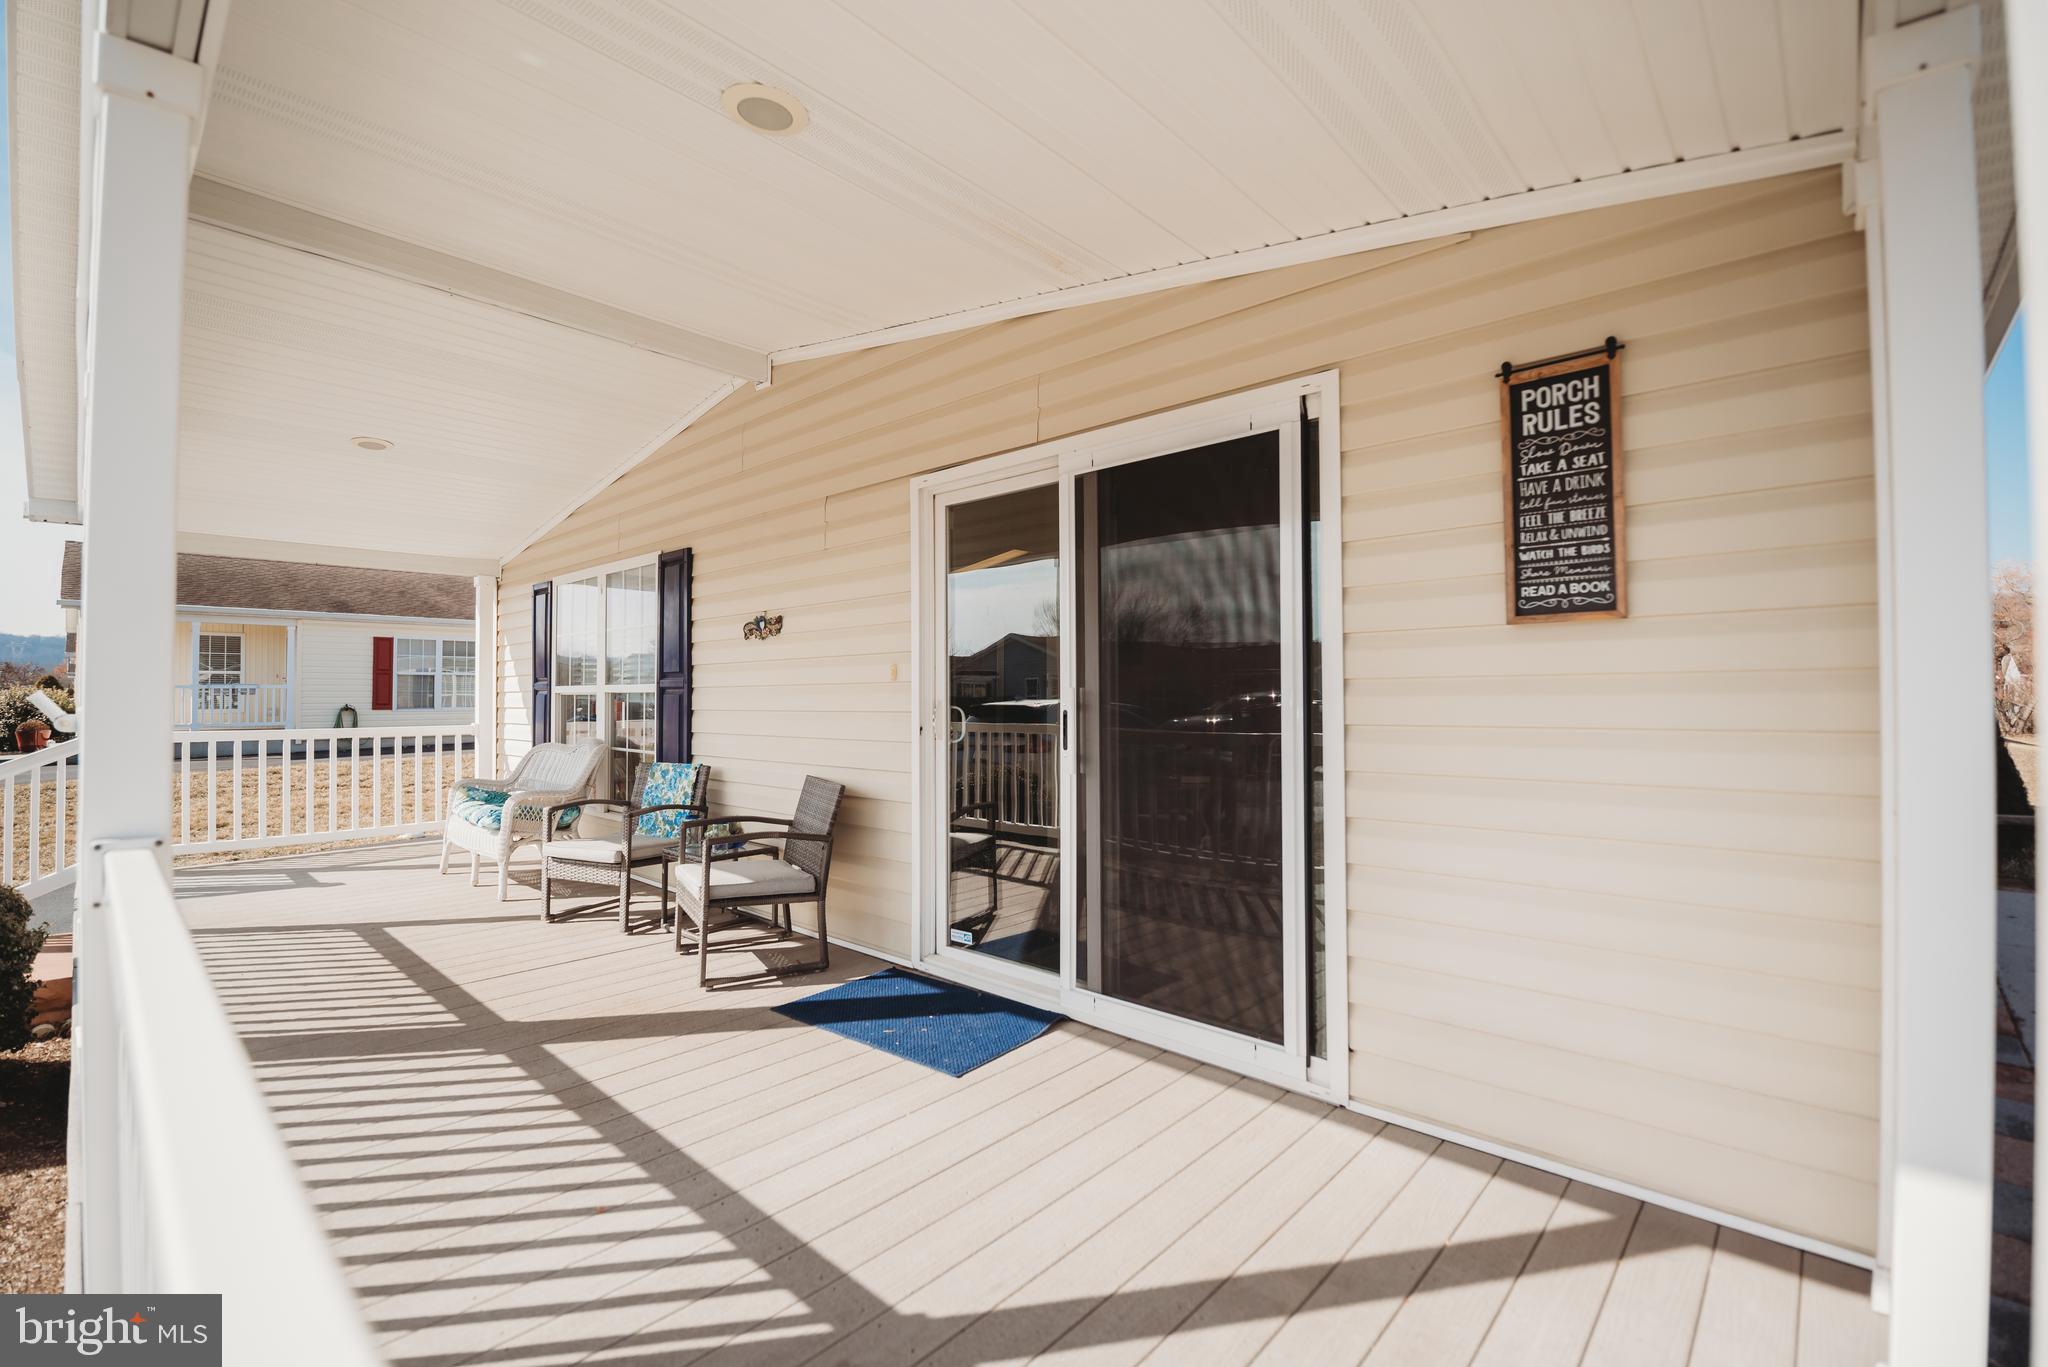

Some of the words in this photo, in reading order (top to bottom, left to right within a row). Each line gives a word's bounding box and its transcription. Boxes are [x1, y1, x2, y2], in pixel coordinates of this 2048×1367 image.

[1521, 375, 1599, 412] PORCH
[1522, 402, 1600, 436] RULES
[1520, 461, 1552, 477] TAKE
[1556, 459, 1567, 471] A
[1572, 452, 1605, 468] SEAT
[1520, 480, 1549, 497] HAVE
[1552, 479, 1561, 492] A
[1565, 472, 1606, 491] DRINK
[1520, 514, 1542, 528] FEEL
[1548, 511, 1565, 524] THE
[1569, 506, 1607, 522] BREEZE
[1520, 531, 1549, 544] RELAX
[1548, 528, 1560, 541] &
[1560, 524, 1609, 540] UNWIND
[1519, 549, 1553, 561] WATCH
[1558, 547, 1577, 557] THE
[1580, 543, 1611, 556] BIRDS
[1520, 585, 1556, 598] READ
[1558, 583, 1568, 595] A
[1569, 580, 1611, 595] BOOK
